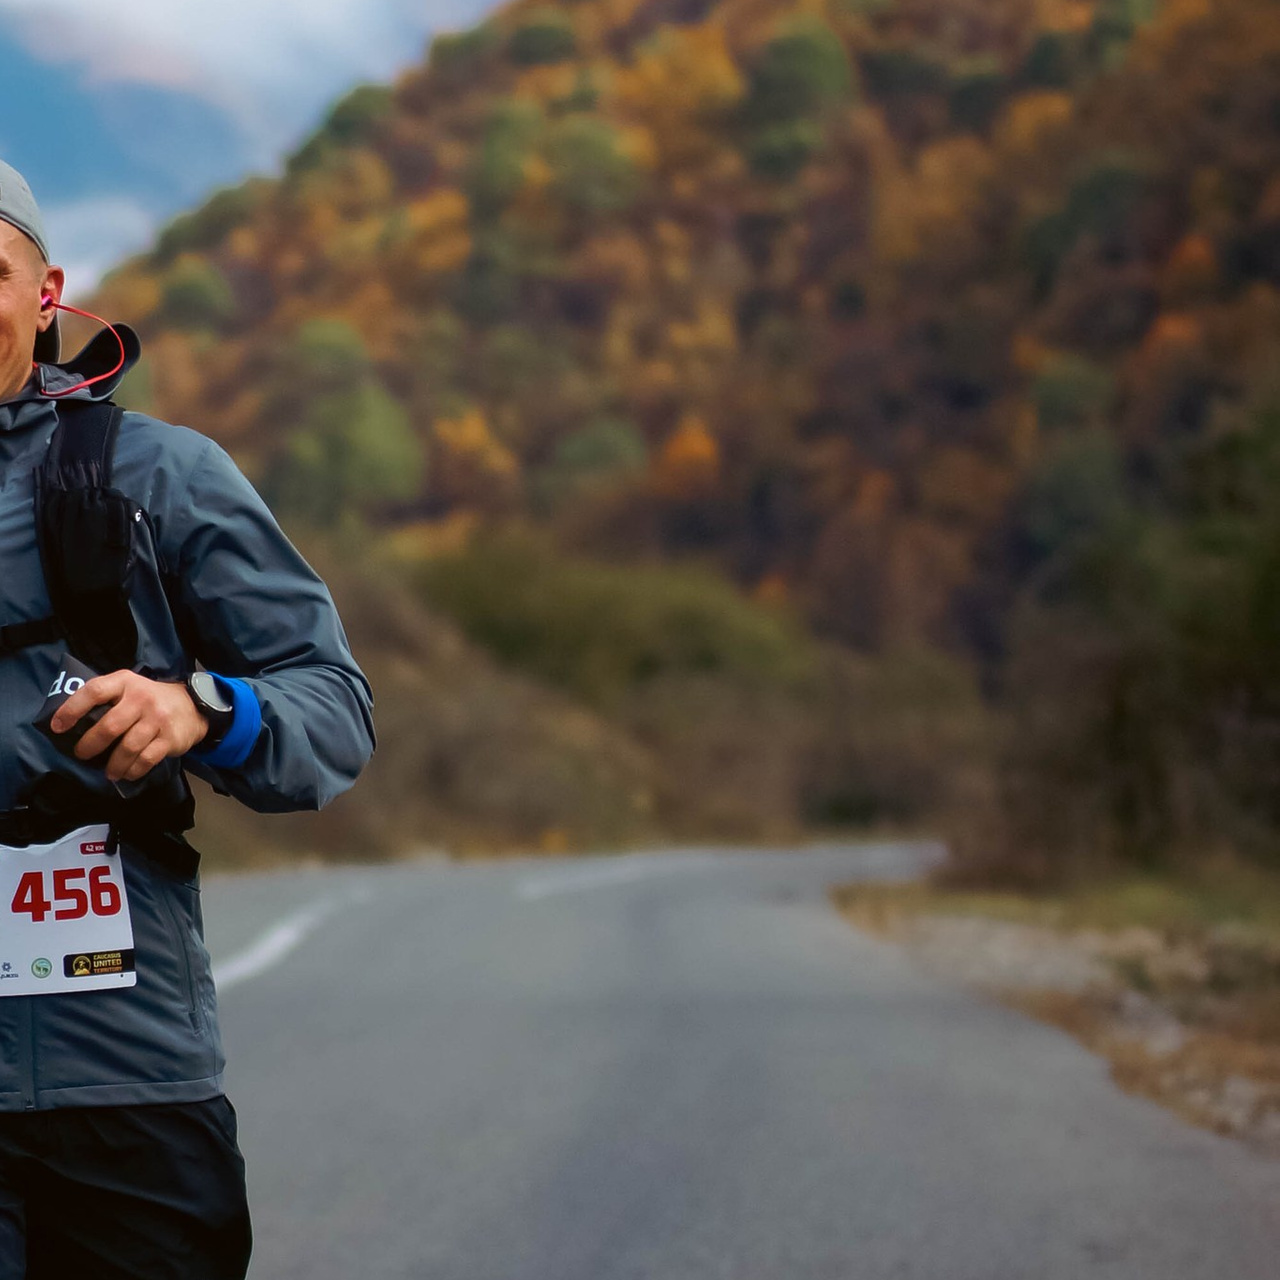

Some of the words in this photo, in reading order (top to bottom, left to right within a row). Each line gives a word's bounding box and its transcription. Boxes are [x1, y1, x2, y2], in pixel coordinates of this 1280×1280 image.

[85, 844, 94, 852] 42
[11, 865, 122, 923] 456
[93, 952, 121, 960] CAUCASUS
[93, 958, 122, 968] UNITED
